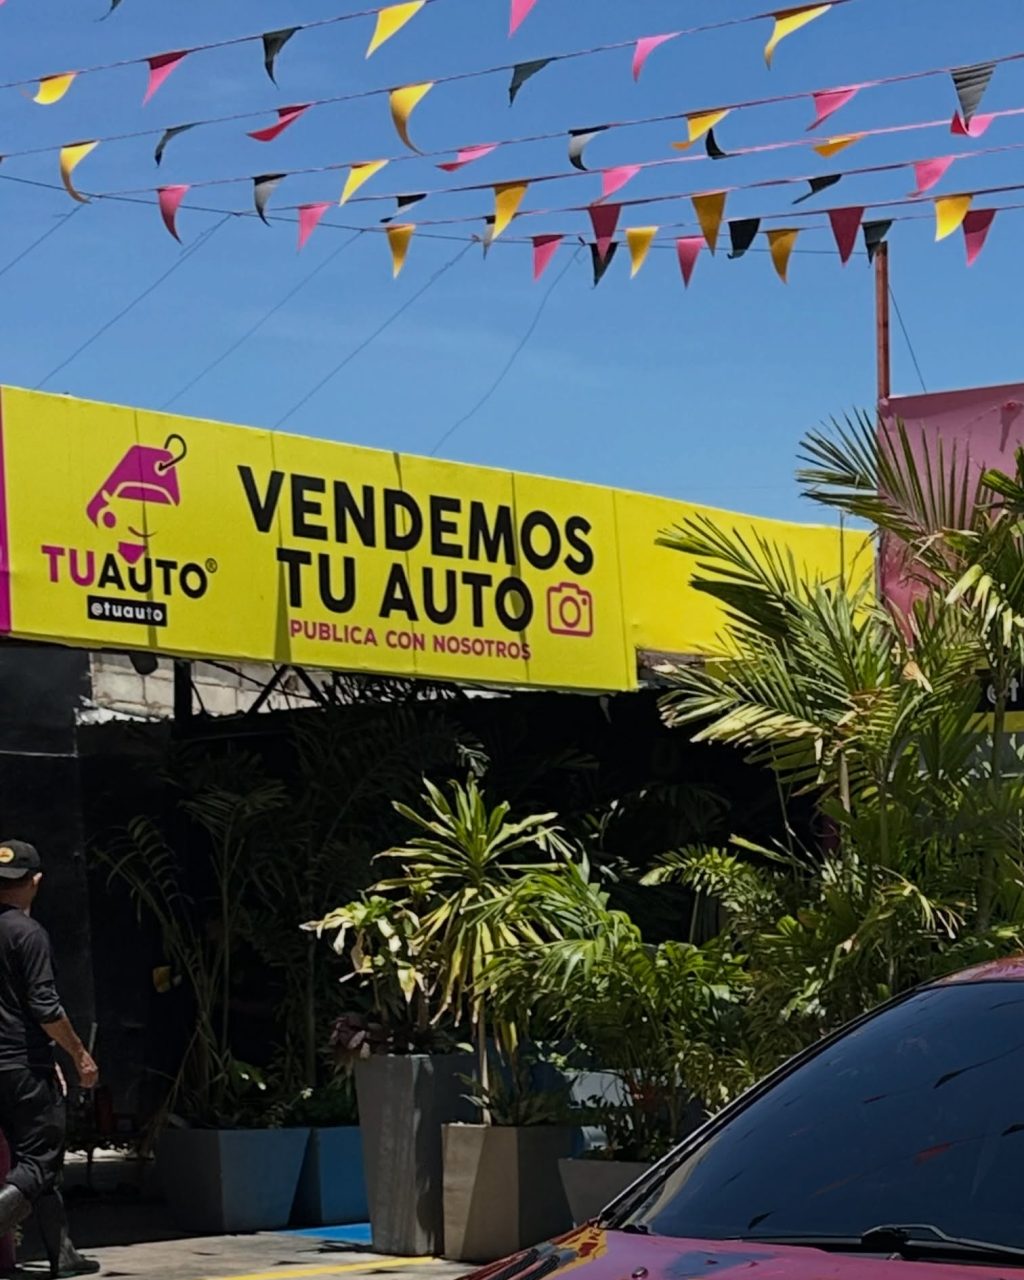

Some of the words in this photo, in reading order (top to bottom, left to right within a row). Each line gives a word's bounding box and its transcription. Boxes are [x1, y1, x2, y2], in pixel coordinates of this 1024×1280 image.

[237, 465, 594, 576] VENDEMOS
[90, 602, 164, 621] @tuauto
[276, 547, 356, 614] TU
[379, 563, 533, 632] AUTO
[290, 620, 377, 646] PUBLICA
[386, 629, 425, 651] CON
[433, 634, 531, 660] NOSOTROS
